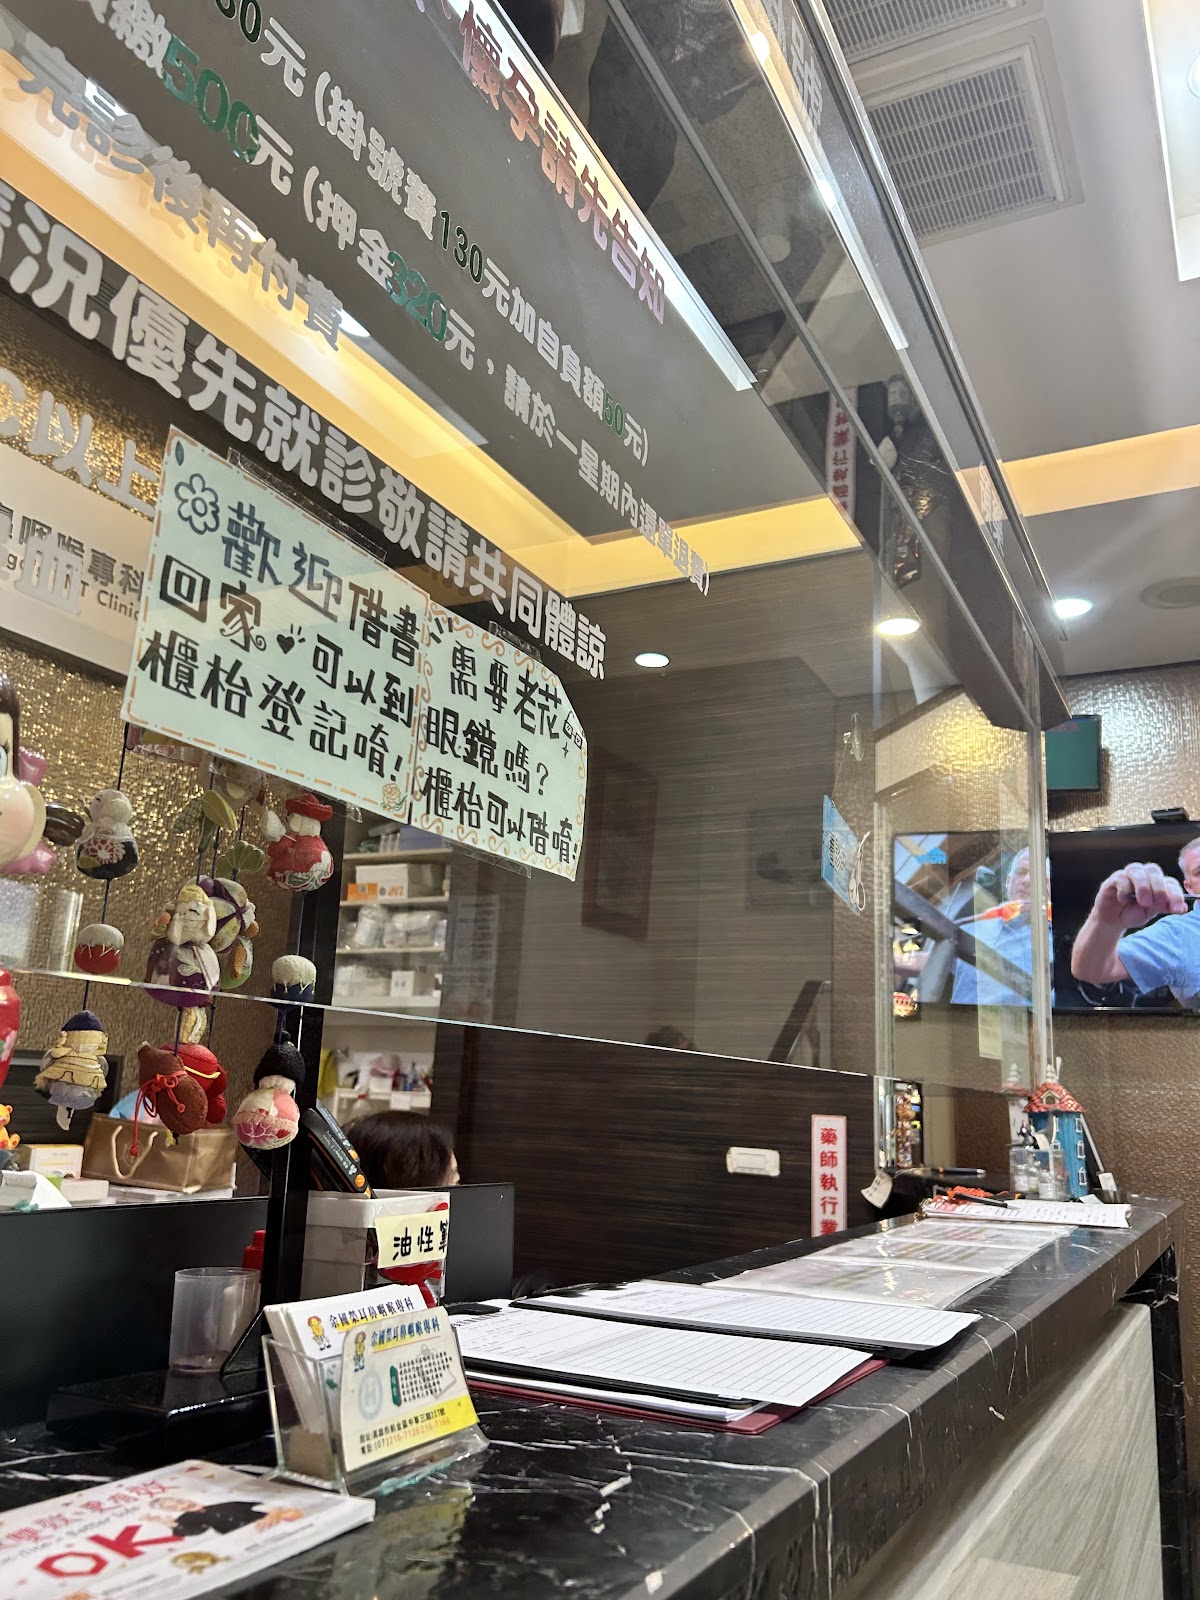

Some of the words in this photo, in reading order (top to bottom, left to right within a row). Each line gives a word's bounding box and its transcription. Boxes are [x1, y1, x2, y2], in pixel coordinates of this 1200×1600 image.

[0, 22, 342, 351] 完診後再付費
[416, 0, 665, 324] 懷孕請先告知
[90, 0, 711, 597] 繳500元(押金320元，請於一星期內還單退費)
[0, 180, 606, 680] 況優先就診敬請共同體諒
[0, 502, 145, 602] 咽喉專科
[221, 501, 420, 667] 歡迎借書
[159, 555, 267, 653] 回家
[312, 633, 415, 728] 可以到
[450, 640, 562, 740] 需要老花
[426, 706, 549, 796] 眼鏡嗎?
[36, 1524, 186, 1579] OK
